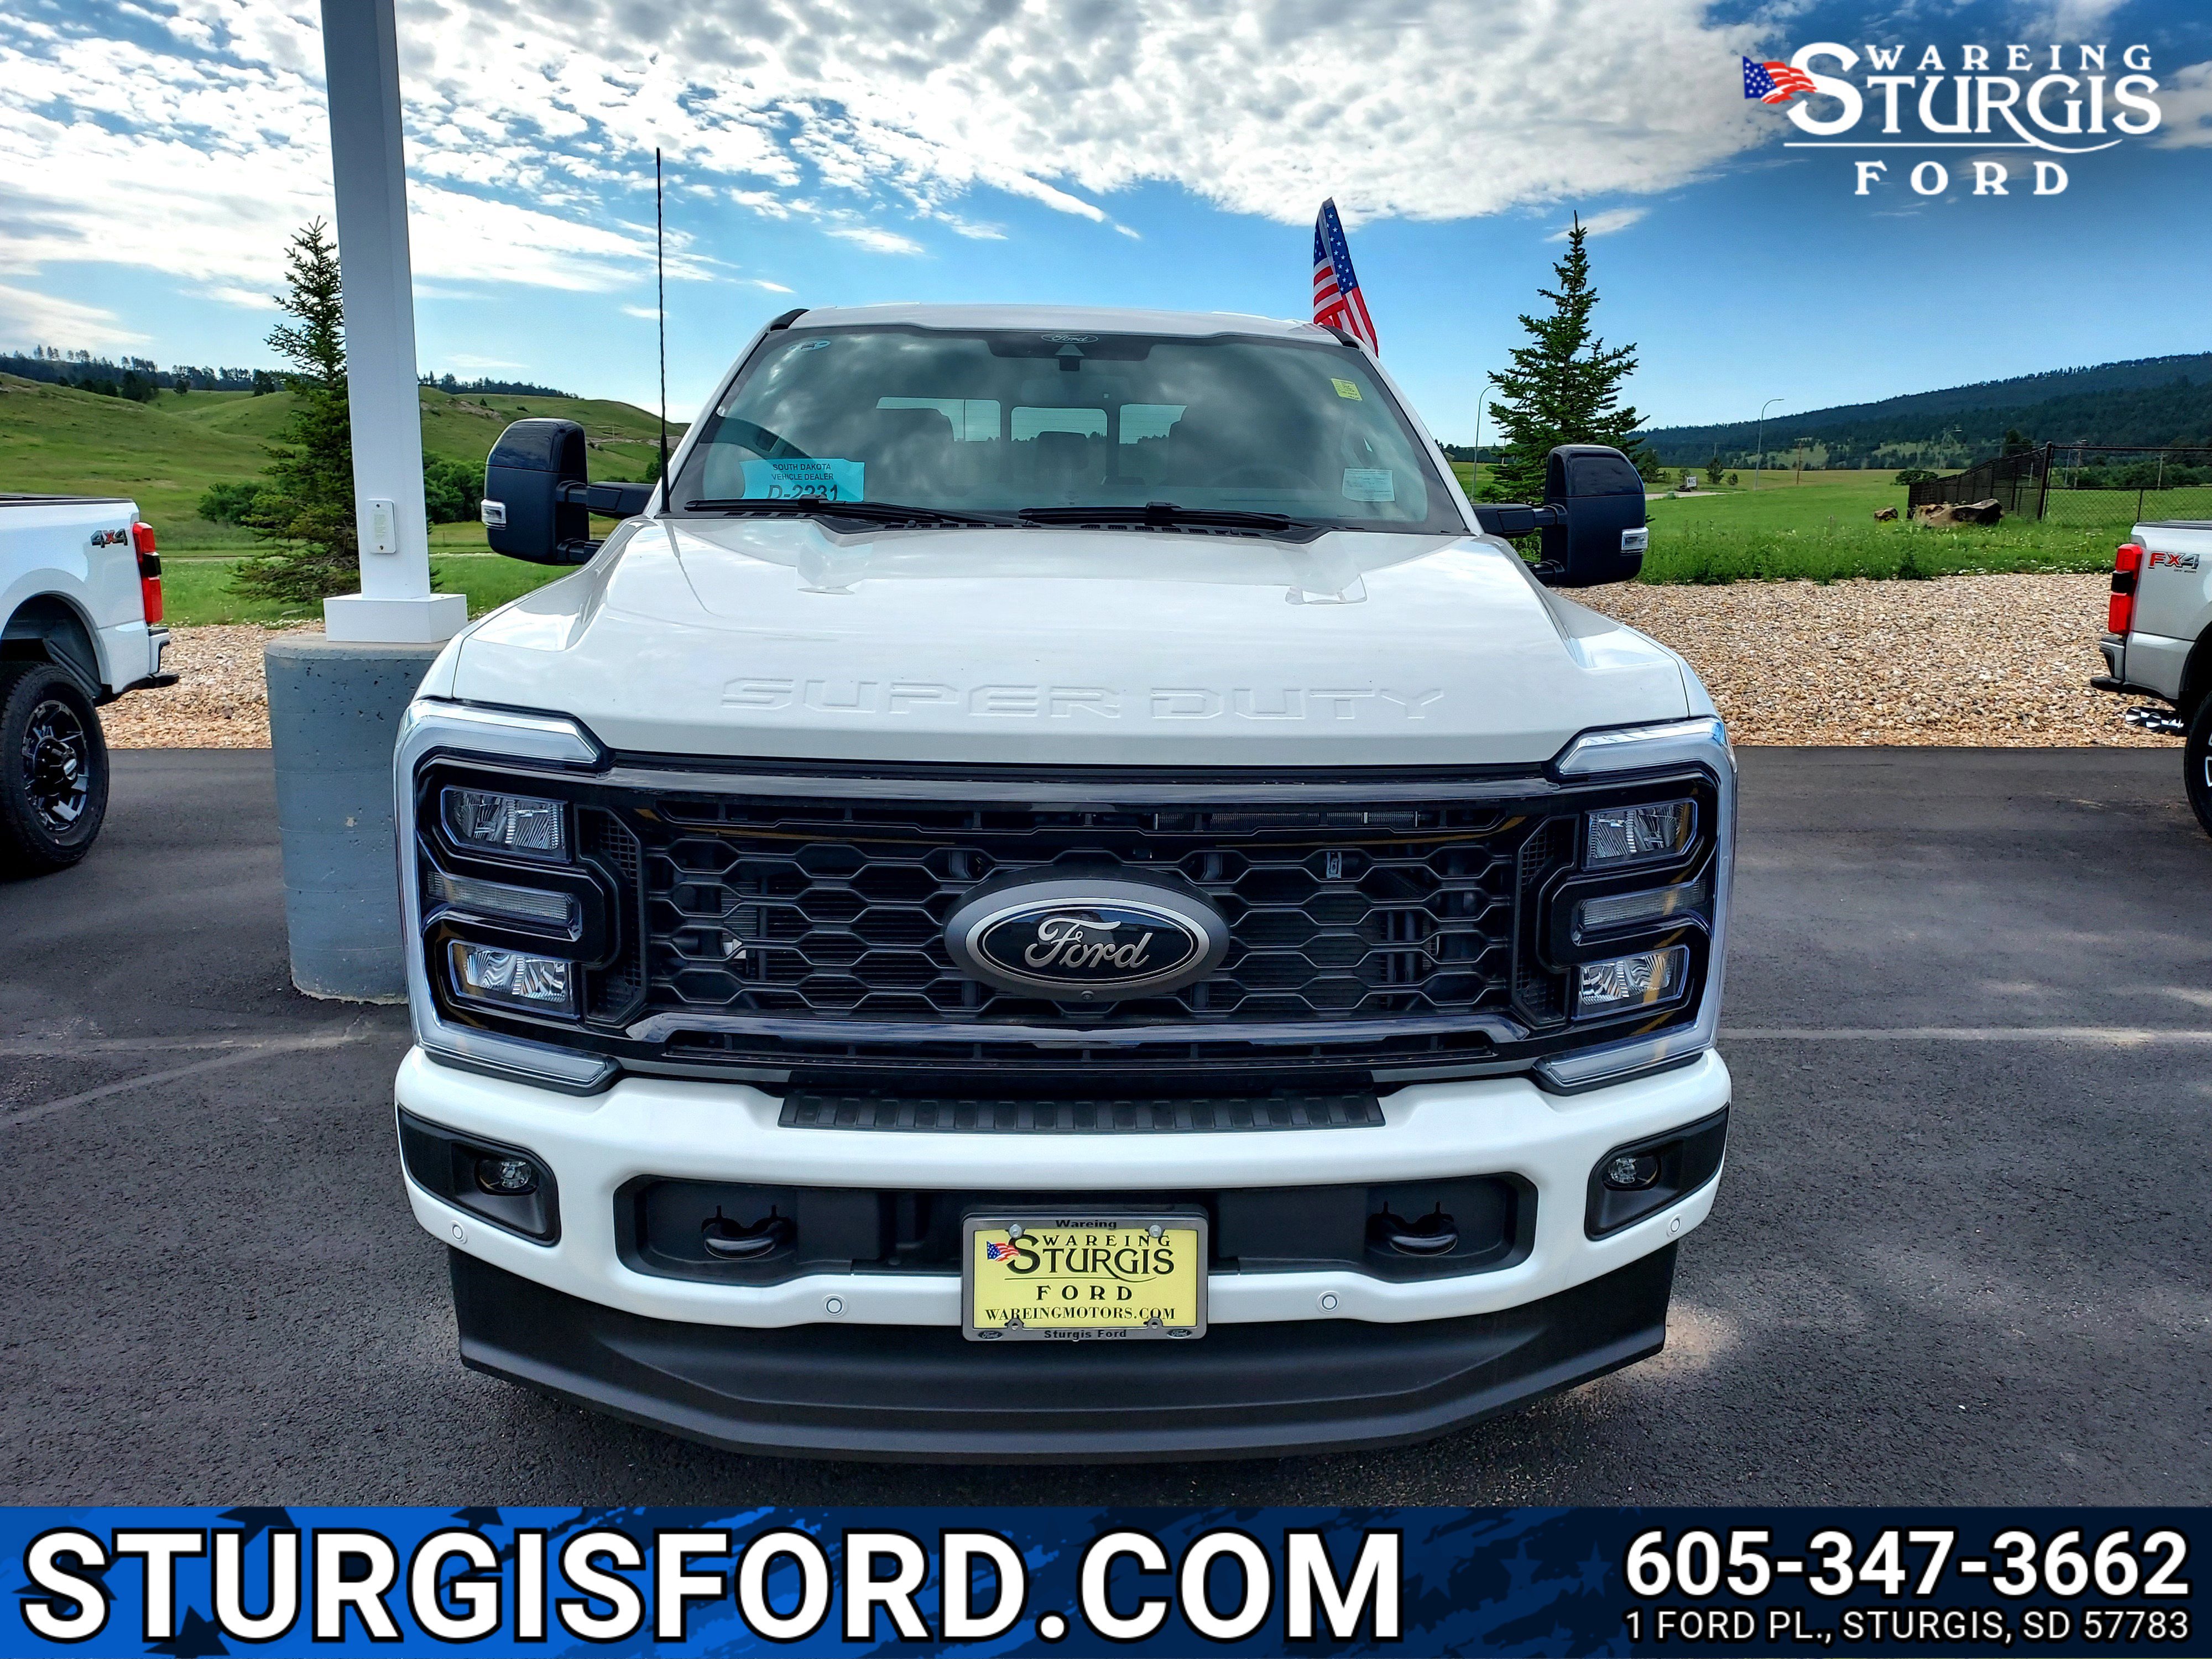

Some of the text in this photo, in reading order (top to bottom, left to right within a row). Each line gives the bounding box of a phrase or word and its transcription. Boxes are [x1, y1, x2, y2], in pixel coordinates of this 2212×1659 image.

[2148, 551, 2200, 570] FX4
[722, 678, 1443, 719] SUPER DUTY
[1024, 917, 1153, 968] Ford
[1055, 1219, 1117, 1229] Wareing
[1042, 1235, 1171, 1246] WAREING
[1006, 1234, 1175, 1281] STURGIS
[1036, 1285, 1133, 1301] FORD
[984, 1307, 1176, 1321] WAREINGMOTORS.COM
[1044, 1329, 1127, 1340] Sturgis Ford
